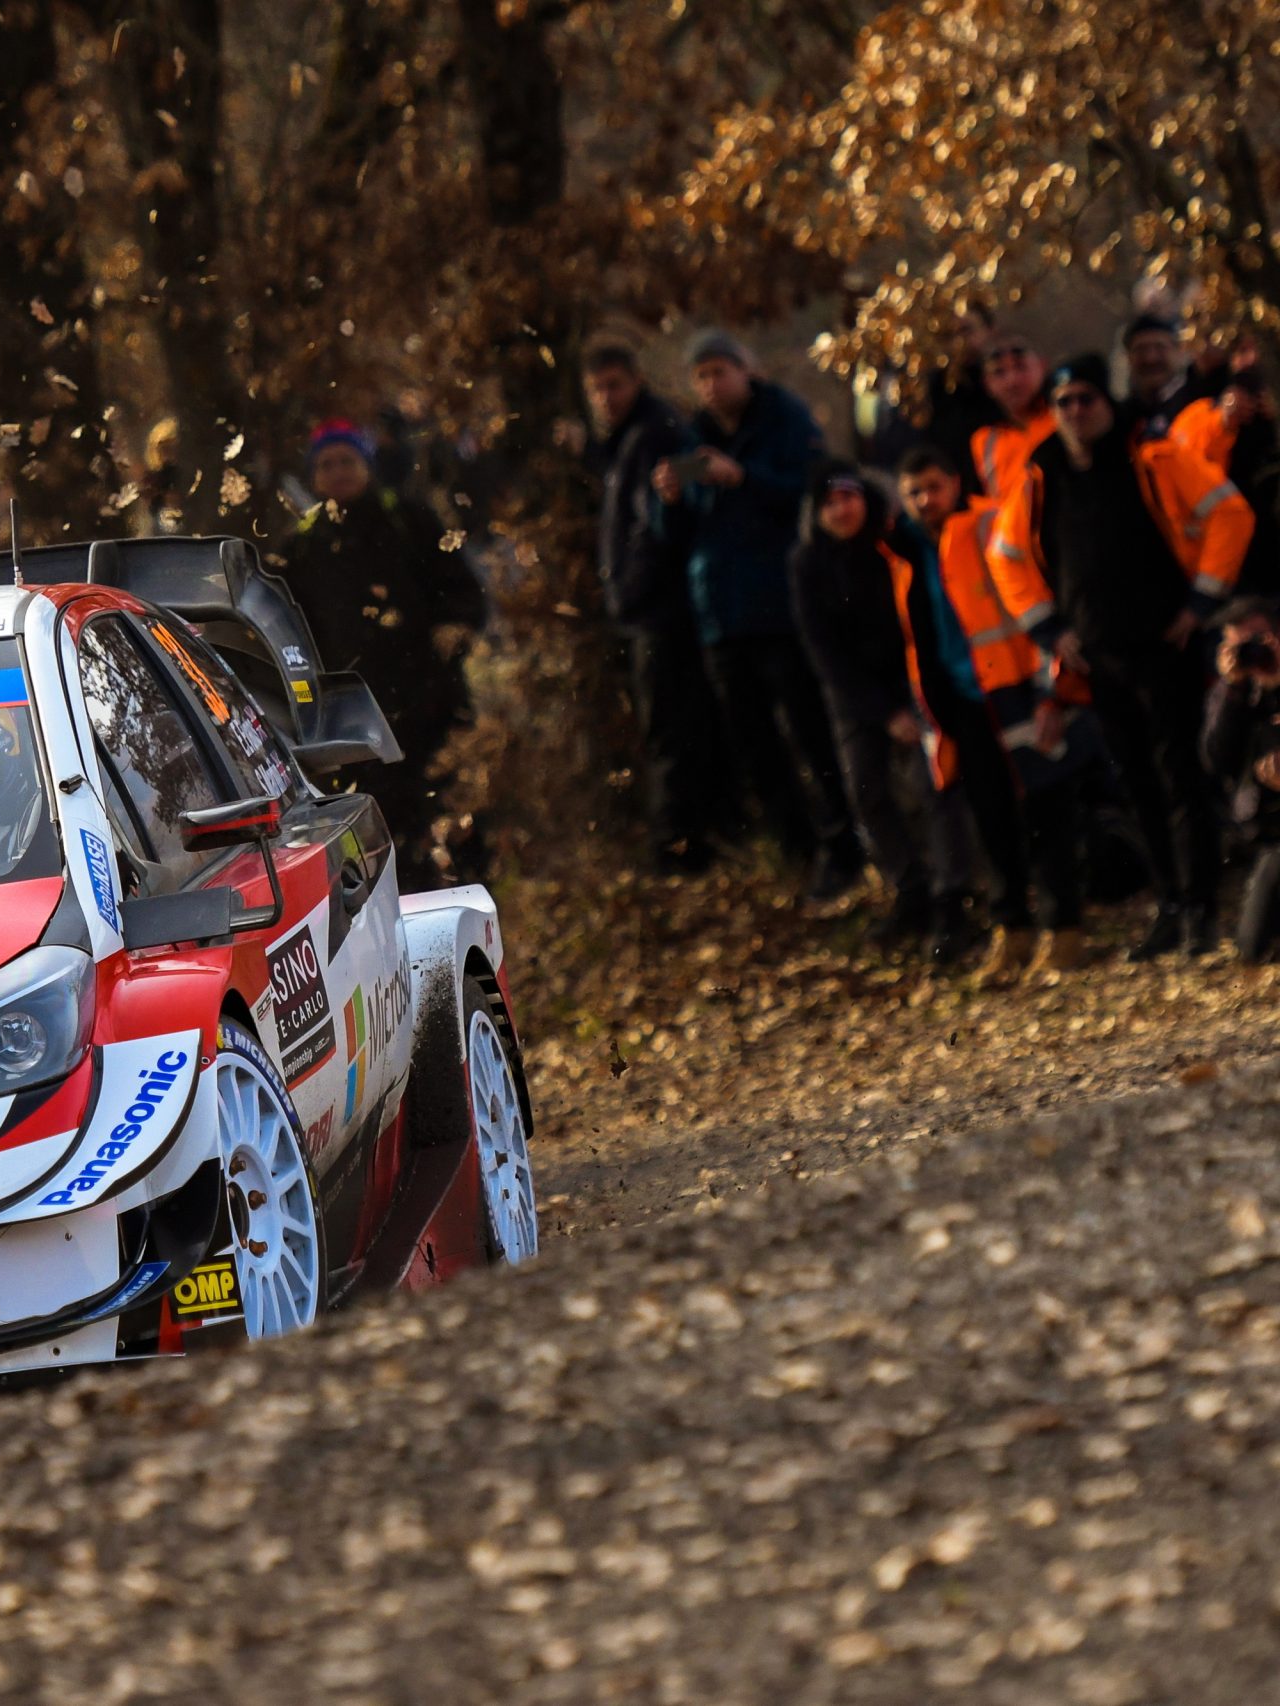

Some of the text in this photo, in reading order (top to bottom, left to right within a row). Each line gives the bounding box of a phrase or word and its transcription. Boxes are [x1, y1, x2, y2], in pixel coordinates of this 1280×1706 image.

[85, 832, 115, 923] AsahiKASEI
[234, 1031, 294, 1113] MICHELIN
[37, 1050, 188, 1206] Panasonic
[174, 1271, 235, 1305] OMP
